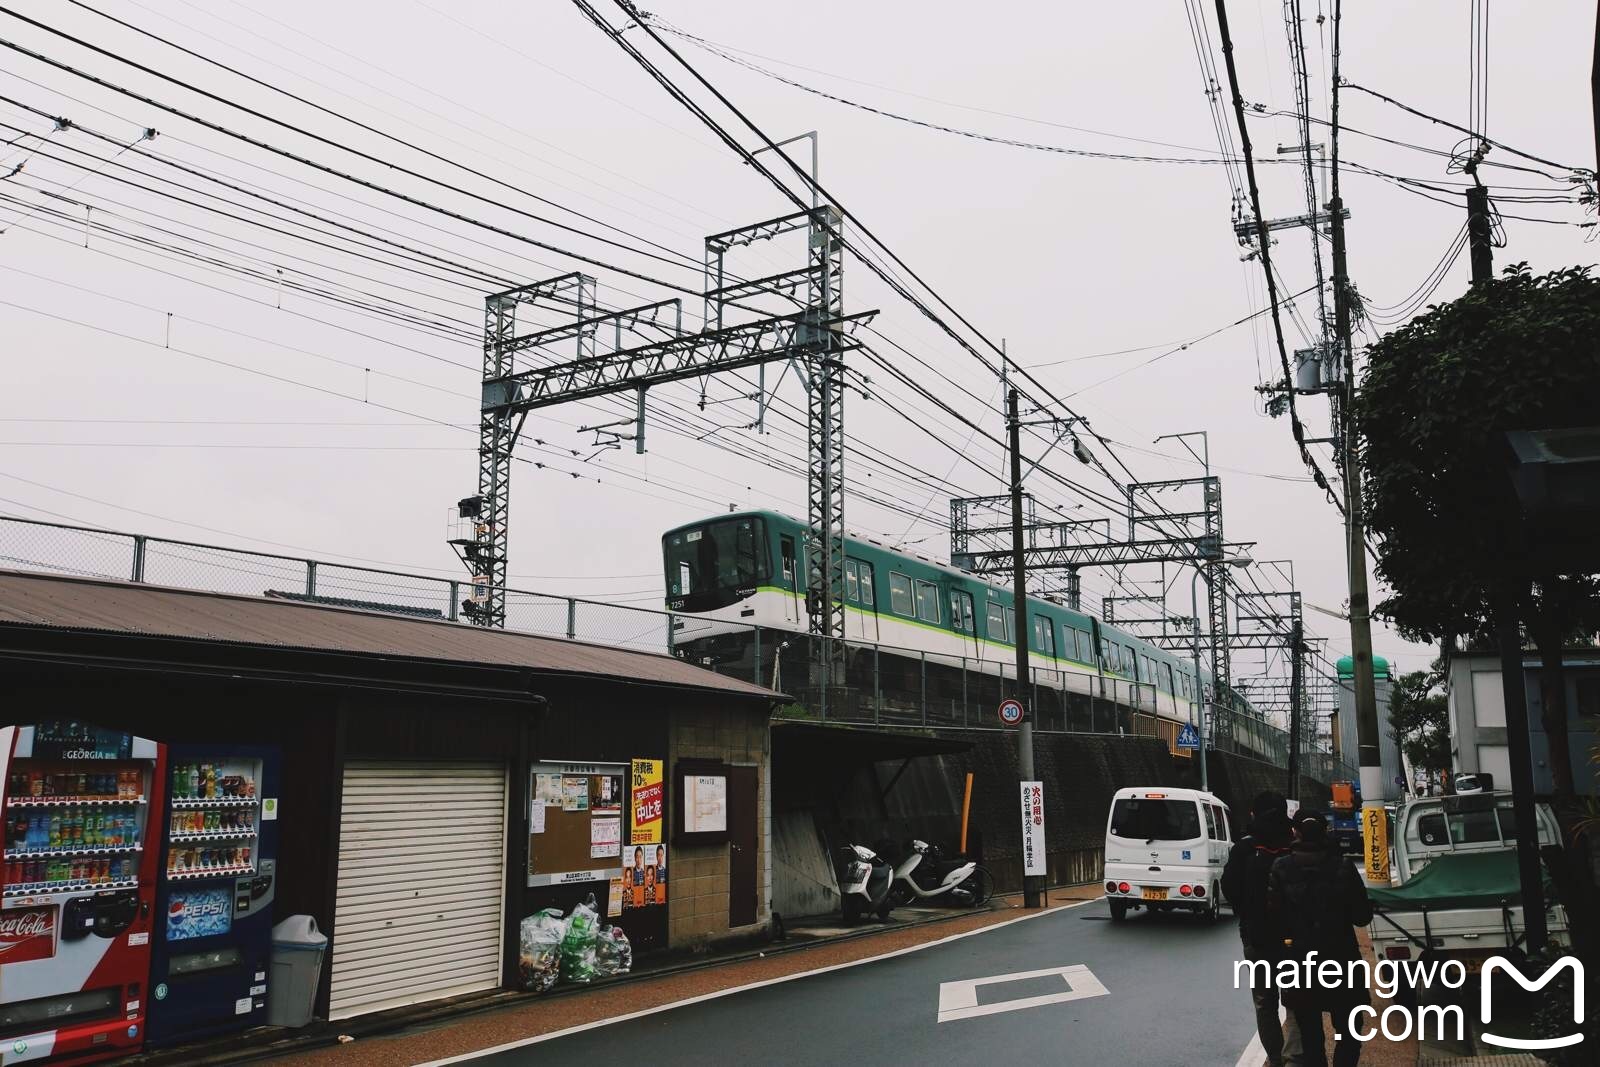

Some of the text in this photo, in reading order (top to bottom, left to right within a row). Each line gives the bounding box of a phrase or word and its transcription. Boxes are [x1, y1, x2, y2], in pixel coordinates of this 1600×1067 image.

[1004, 706, 1018, 719] 30
[67, 750, 103, 760] GEORGIA
[636, 799, 663, 822] 中止を
[1031, 786, 1042, 826] 火の用心
[1369, 810, 1380, 871] スピードおとせ
[183, 902, 225, 918] PEPSI
